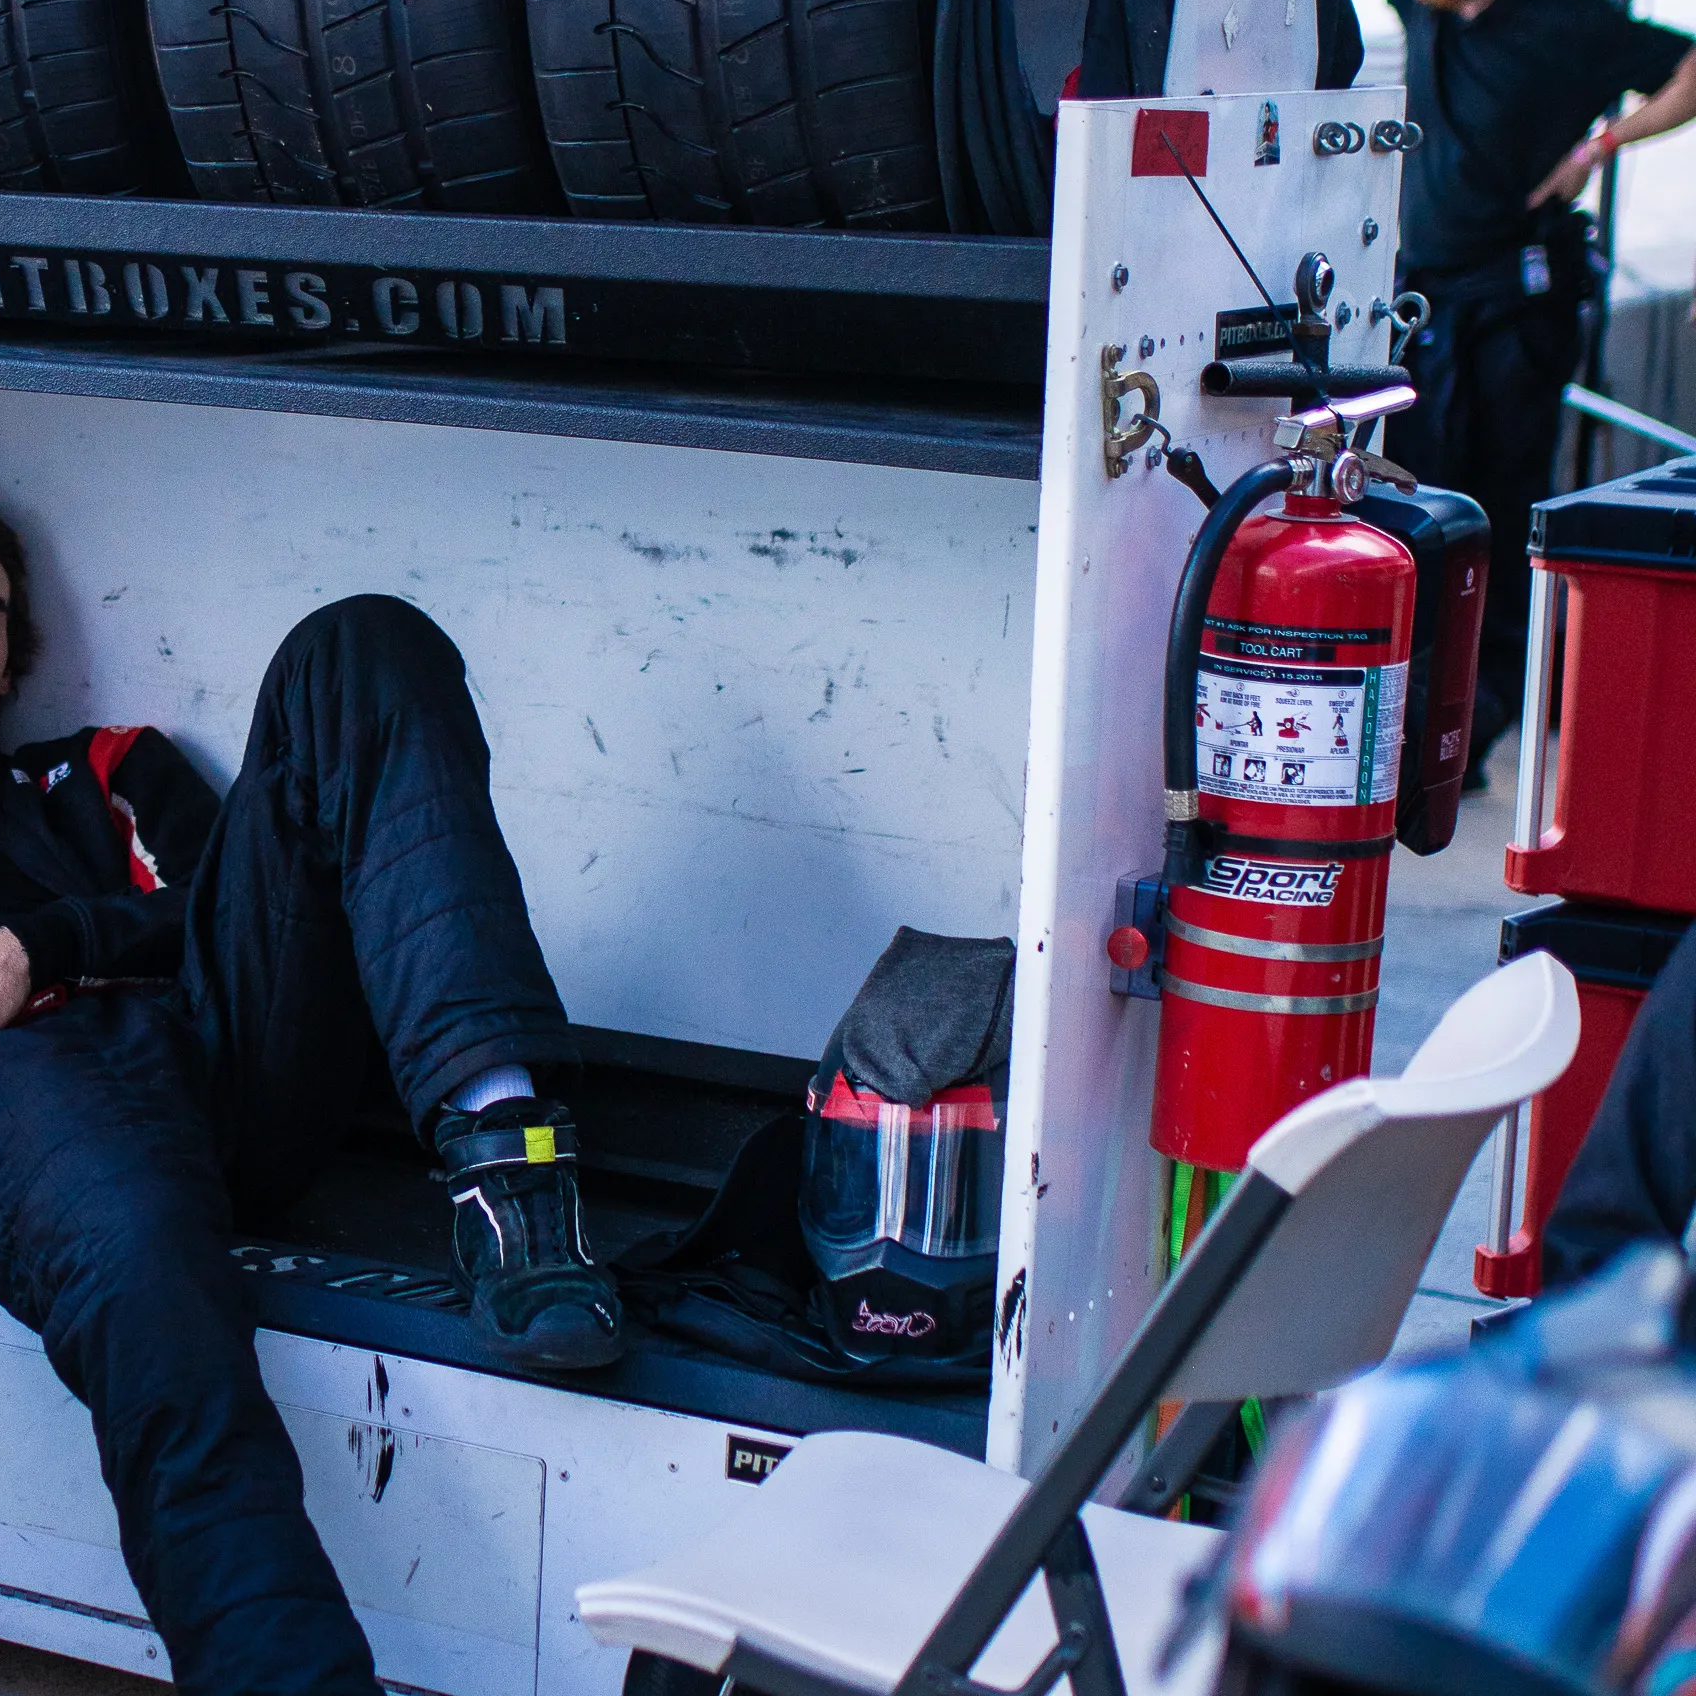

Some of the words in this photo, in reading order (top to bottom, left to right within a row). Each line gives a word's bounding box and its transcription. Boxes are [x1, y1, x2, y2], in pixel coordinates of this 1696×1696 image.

[1227, 623, 1246, 632] ASK
[1248, 626, 1271, 635] FOR
[1274, 629, 1344, 640] INSPECTION
[1347, 632, 1368, 641] TAG
[1240, 641, 1268, 656] TOOL
[1270, 646, 1303, 658] CART
[1214, 663, 1223, 671] IN
[1223, 665, 1266, 678] SERVICE
[1275, 697, 1296, 705] SQUEEZE
[1360, 672, 1377, 800] HALOTRON
[1209, 857, 1343, 895] Sport
[1243, 887, 1334, 903] RACING
